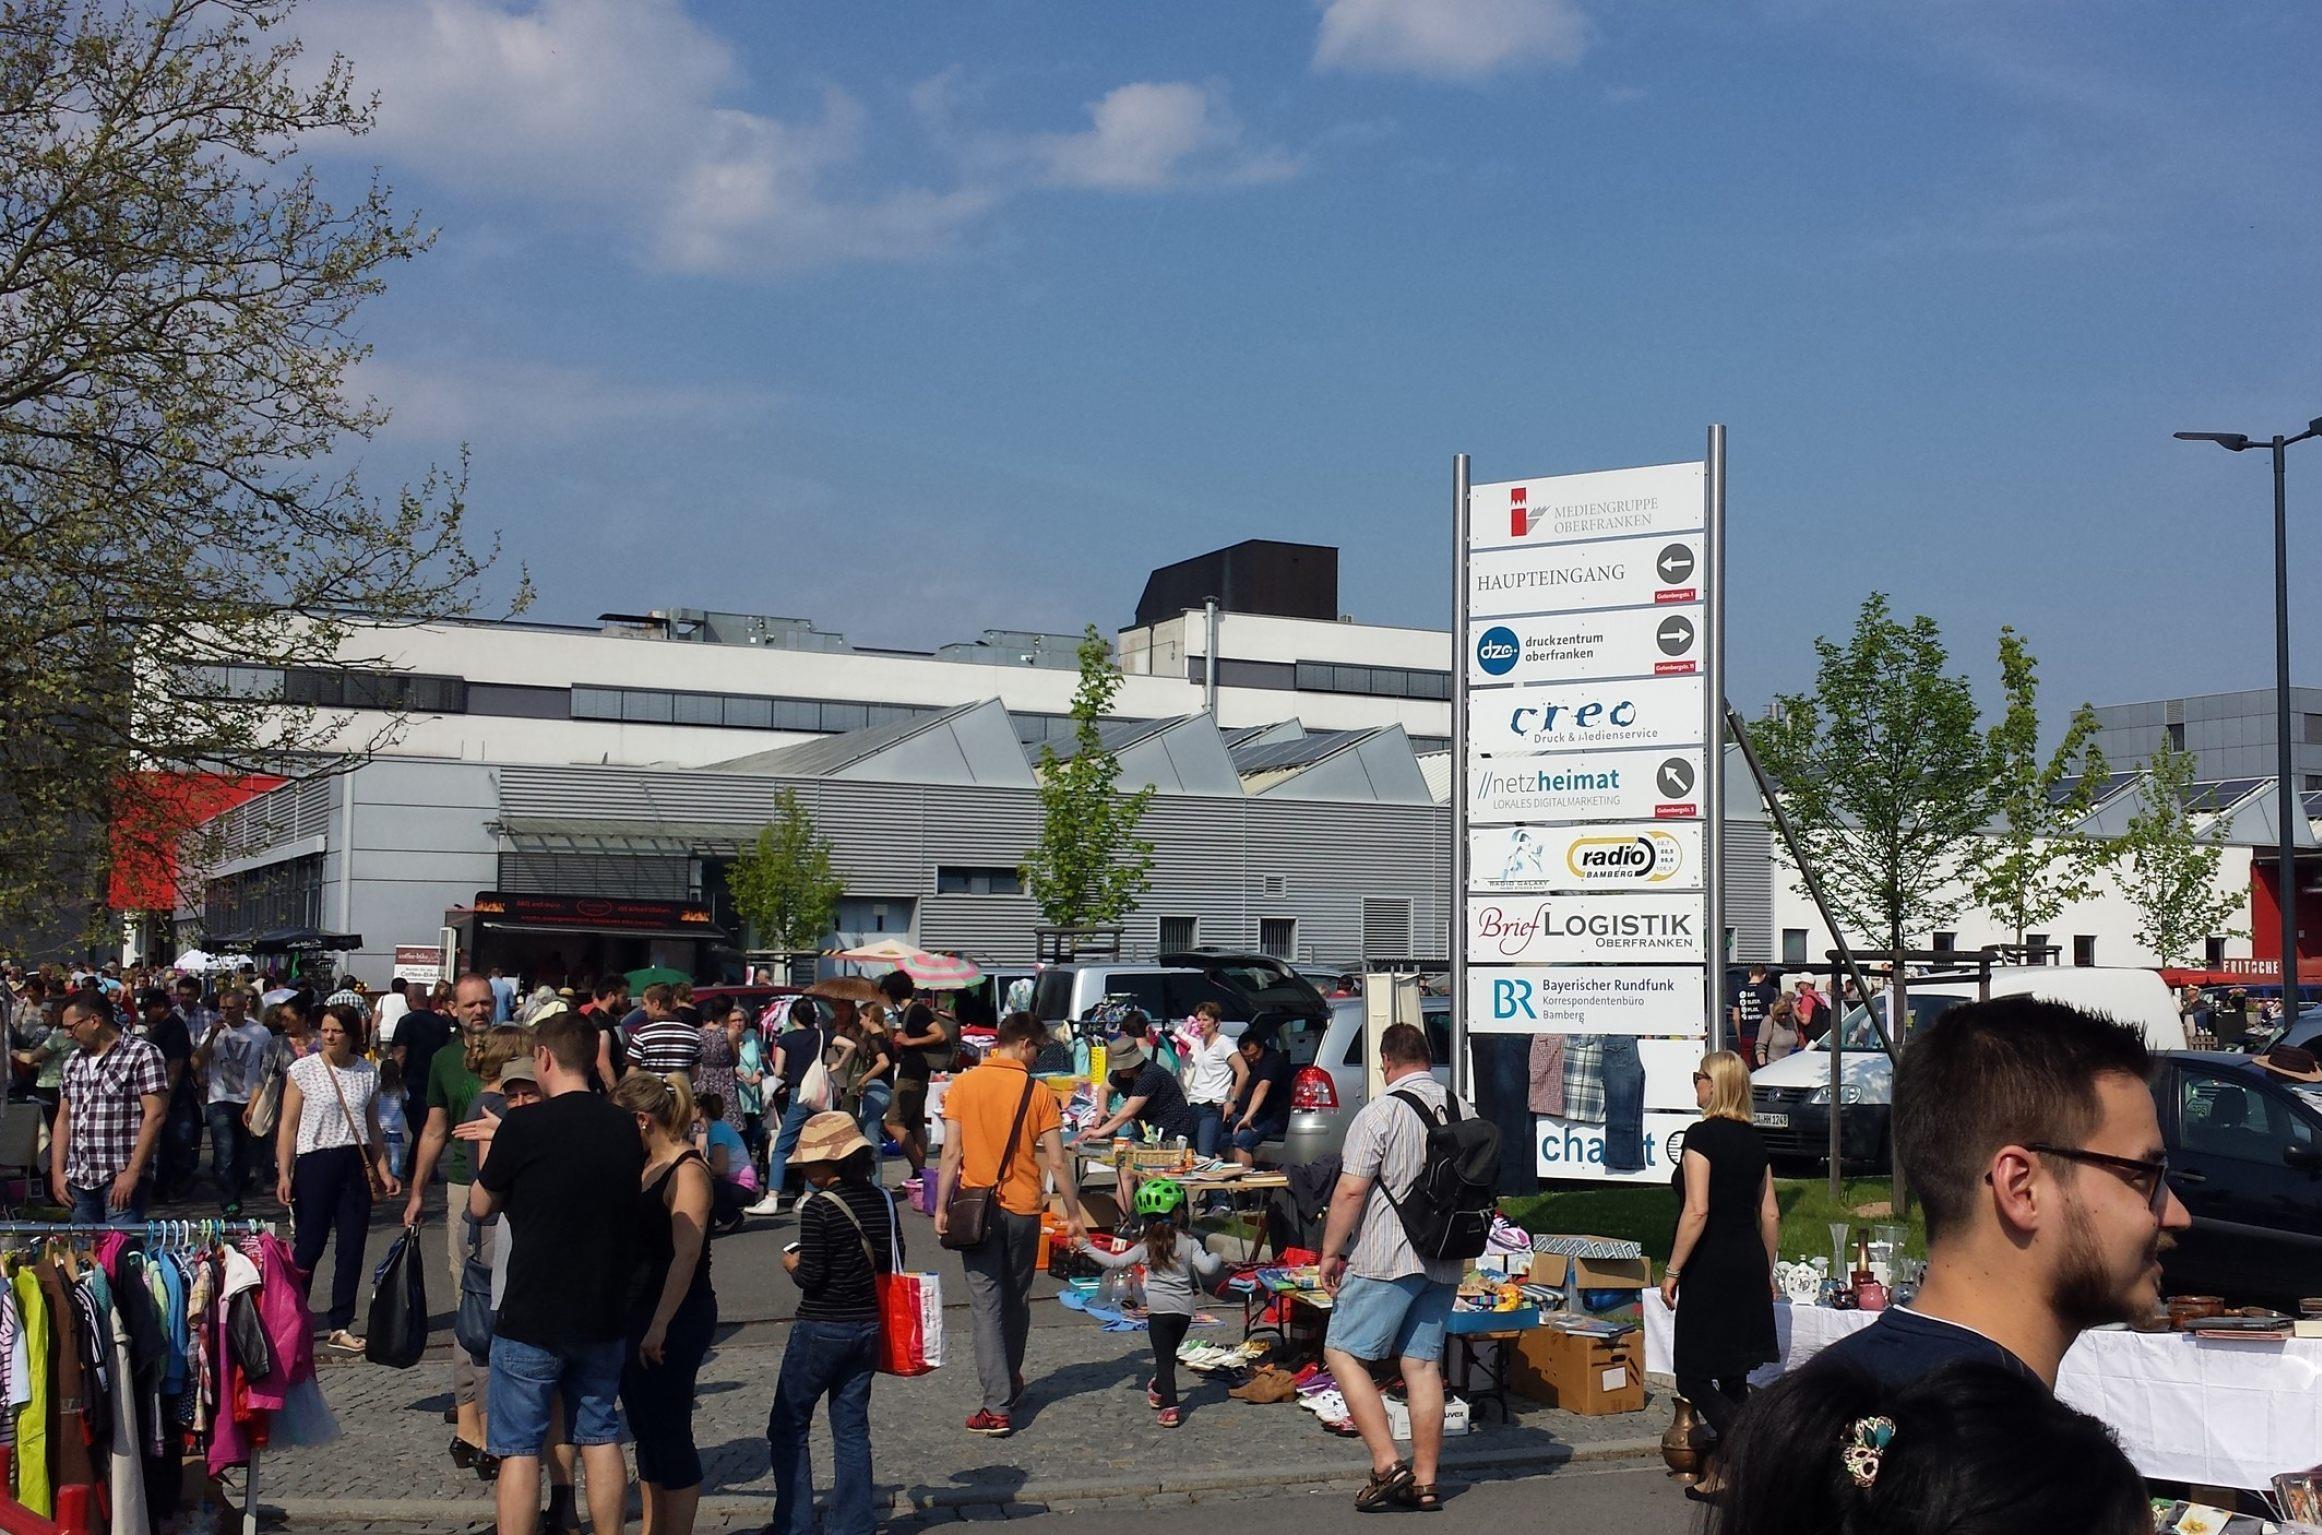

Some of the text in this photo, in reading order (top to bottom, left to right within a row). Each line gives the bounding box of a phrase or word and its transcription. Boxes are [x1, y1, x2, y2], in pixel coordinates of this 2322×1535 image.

[1554, 498, 1659, 518] MEDIENGRUPPE
[1554, 514, 1652, 534] OBERFRANKEN
[1477, 564, 1626, 591] HAUPTEINGANG
[1525, 633, 1604, 648] druckzentrum
[1525, 649, 1594, 662] oberfranken
[1510, 701, 1636, 736] creo
[1534, 730, 1658, 744] Druck & Medienservice
[1493, 798, 1532, 809] LOKALES
[1582, 845, 1646, 866] radio
[1586, 871, 1633, 879] BAMBERG
[1595, 937, 1693, 948] OBERFRANKEN
[1543, 978, 1675, 993] Bayerischer Rundfunk
[1493, 979, 1537, 1019] BR
[1543, 996, 1645, 1007] Korrespondentenbüro
[1543, 1010, 1585, 1022] Bamberg
